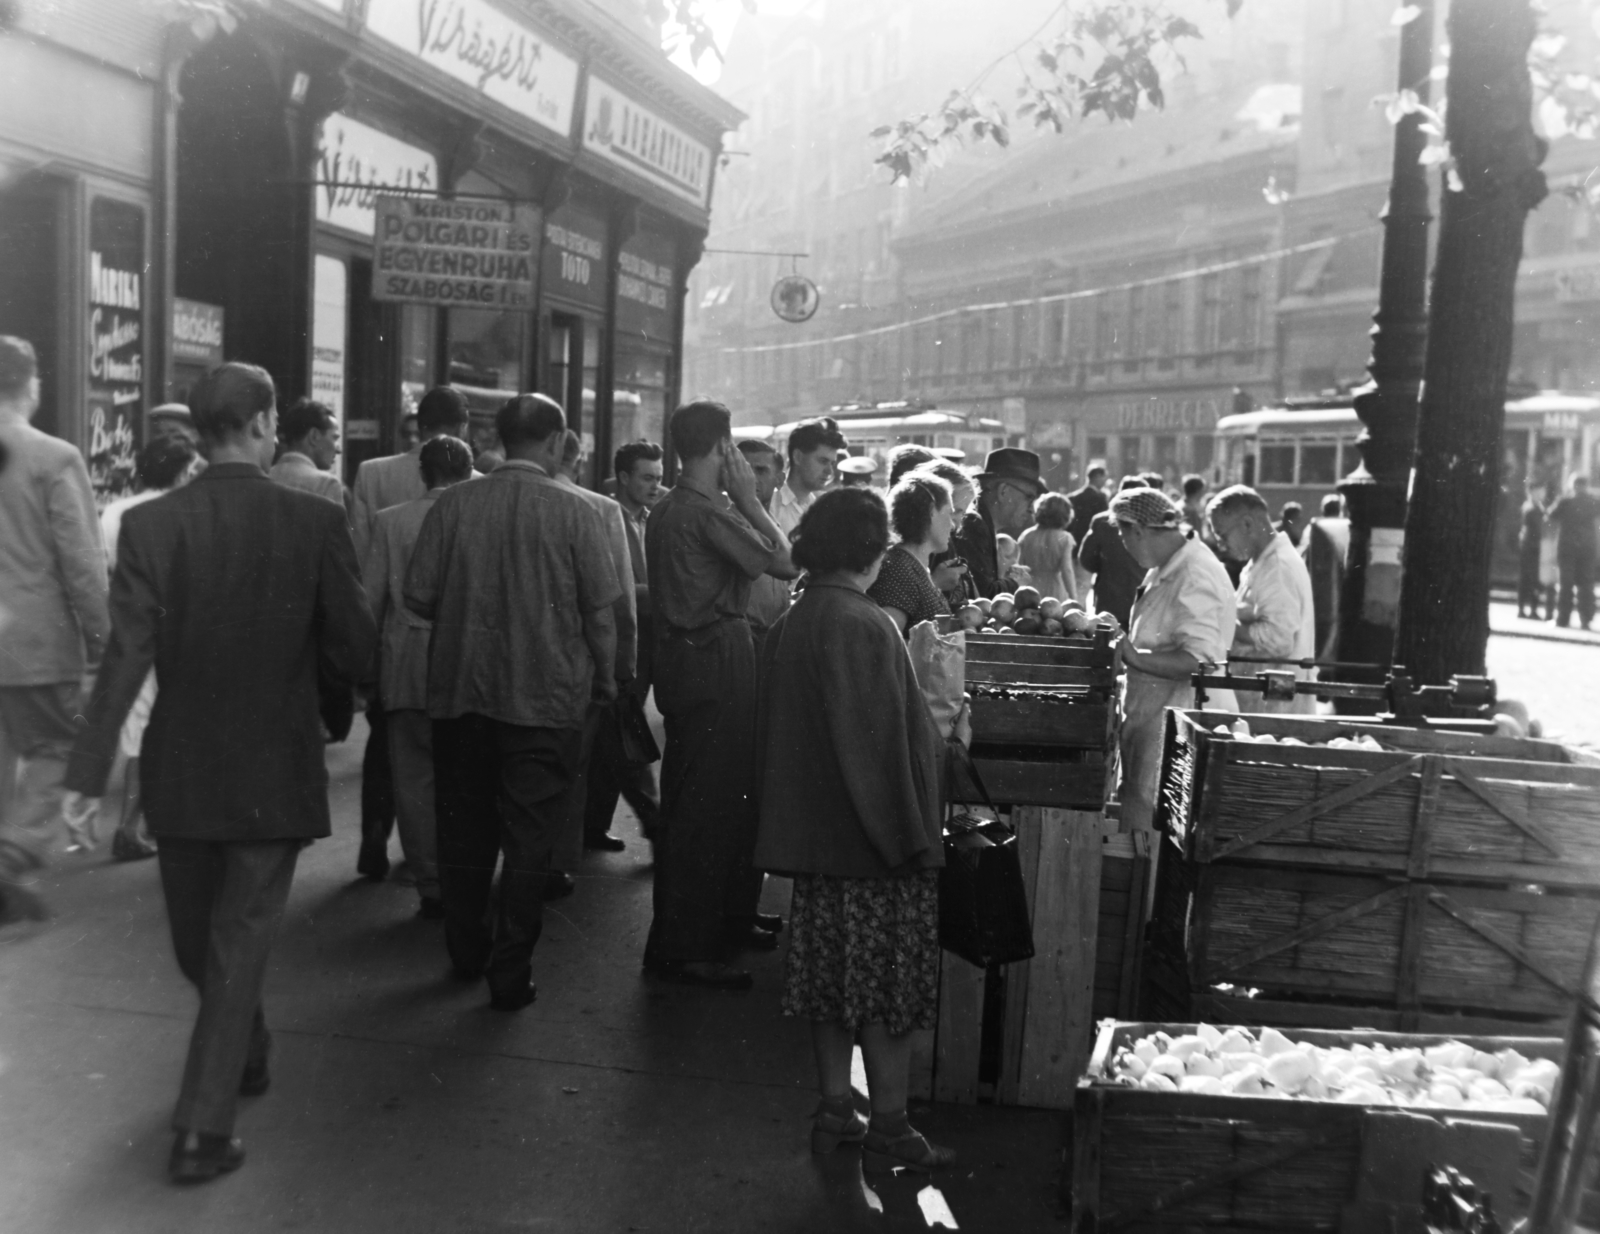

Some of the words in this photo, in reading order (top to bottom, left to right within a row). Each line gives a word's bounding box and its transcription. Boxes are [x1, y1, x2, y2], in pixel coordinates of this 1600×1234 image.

[414, 202, 503, 223] KRISTON
[507, 228, 531, 251] ÉS
[379, 245, 530, 280] EGYENRUHA
[561, 250, 590, 285] TOTO
[386, 275, 494, 302] SZABÓSÁG
